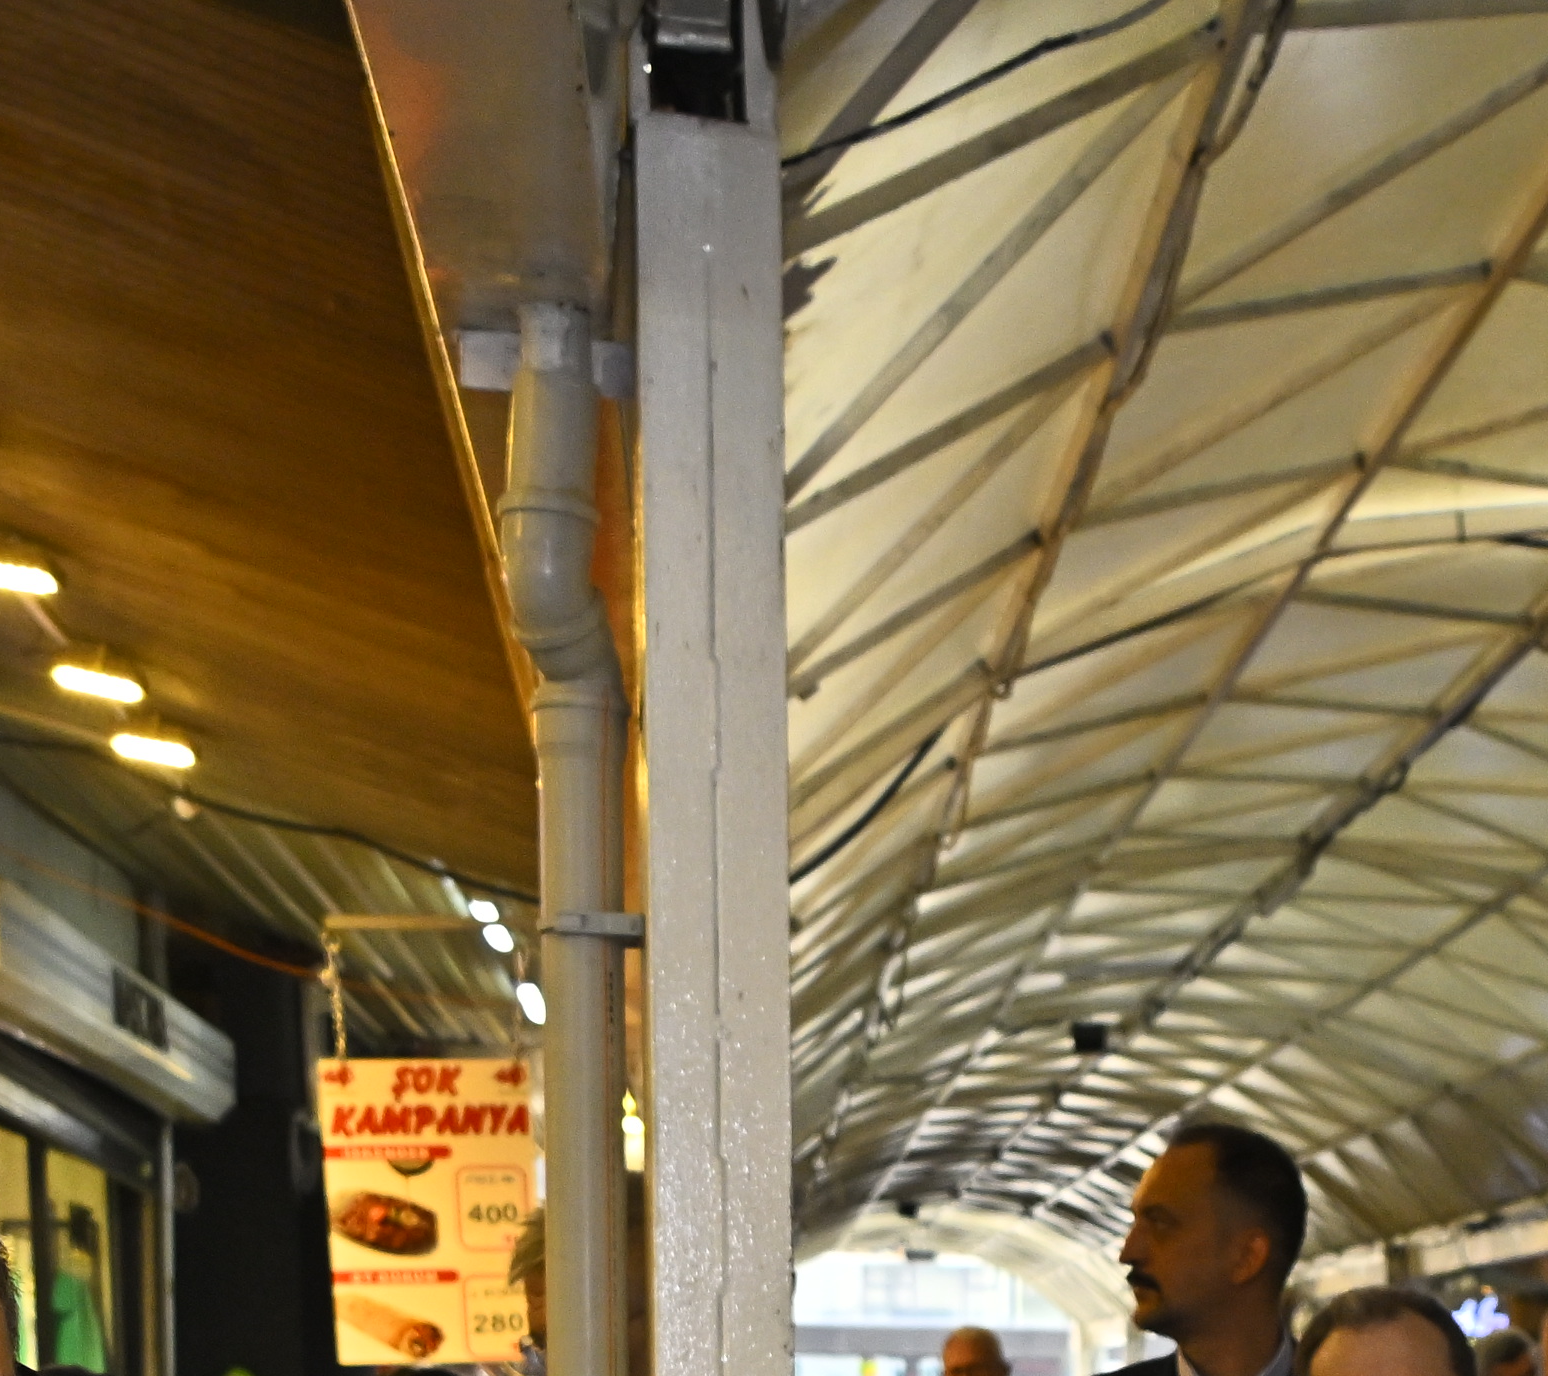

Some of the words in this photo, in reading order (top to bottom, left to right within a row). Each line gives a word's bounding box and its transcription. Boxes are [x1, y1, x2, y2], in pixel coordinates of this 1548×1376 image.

[390, 1065, 463, 1101] ŞOK
[331, 1103, 530, 1138] KAMPANYA
[468, 1202, 518, 1225] 400
[473, 1313, 524, 1335] 280
